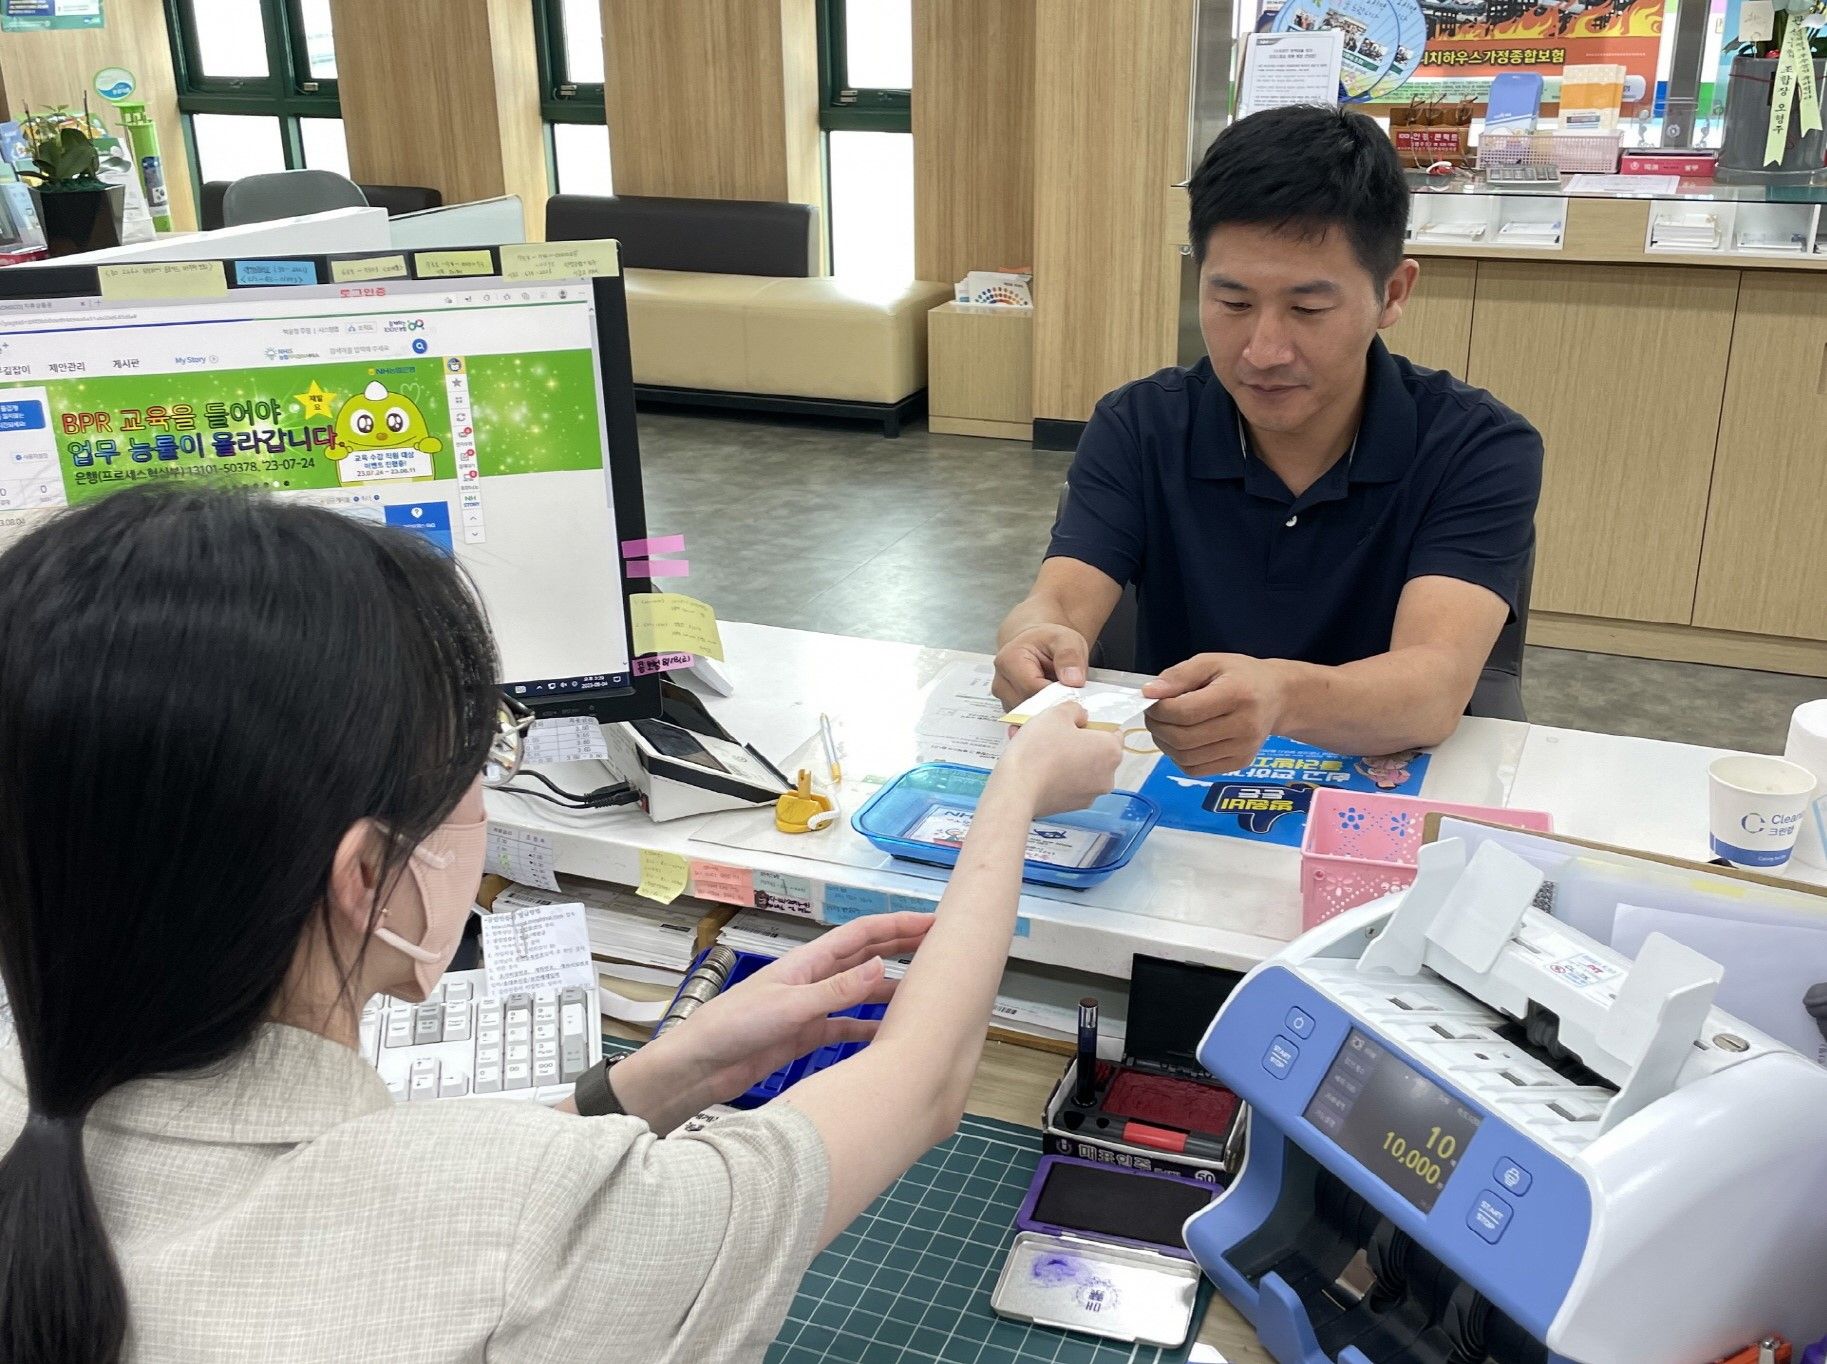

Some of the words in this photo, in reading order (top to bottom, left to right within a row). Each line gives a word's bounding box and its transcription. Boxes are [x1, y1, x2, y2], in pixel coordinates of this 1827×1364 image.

[48, 362, 87, 374] 제안관리
[112, 358, 140, 369] 게시판
[175, 357, 186, 366] My
[186, 356, 206, 365] Story
[61, 411, 113, 435] BPR
[119, 403, 197, 433] 교육을
[203, 397, 282, 430] 들어야
[67, 438, 121, 468] 업무
[1273, 1044, 1292, 1061] START
[1270, 1056, 1285, 1068] STOP
[1426, 1126, 1456, 1159] 10
[1480, 1200, 1504, 1220] START
[1476, 1212, 1496, 1230] STOP
